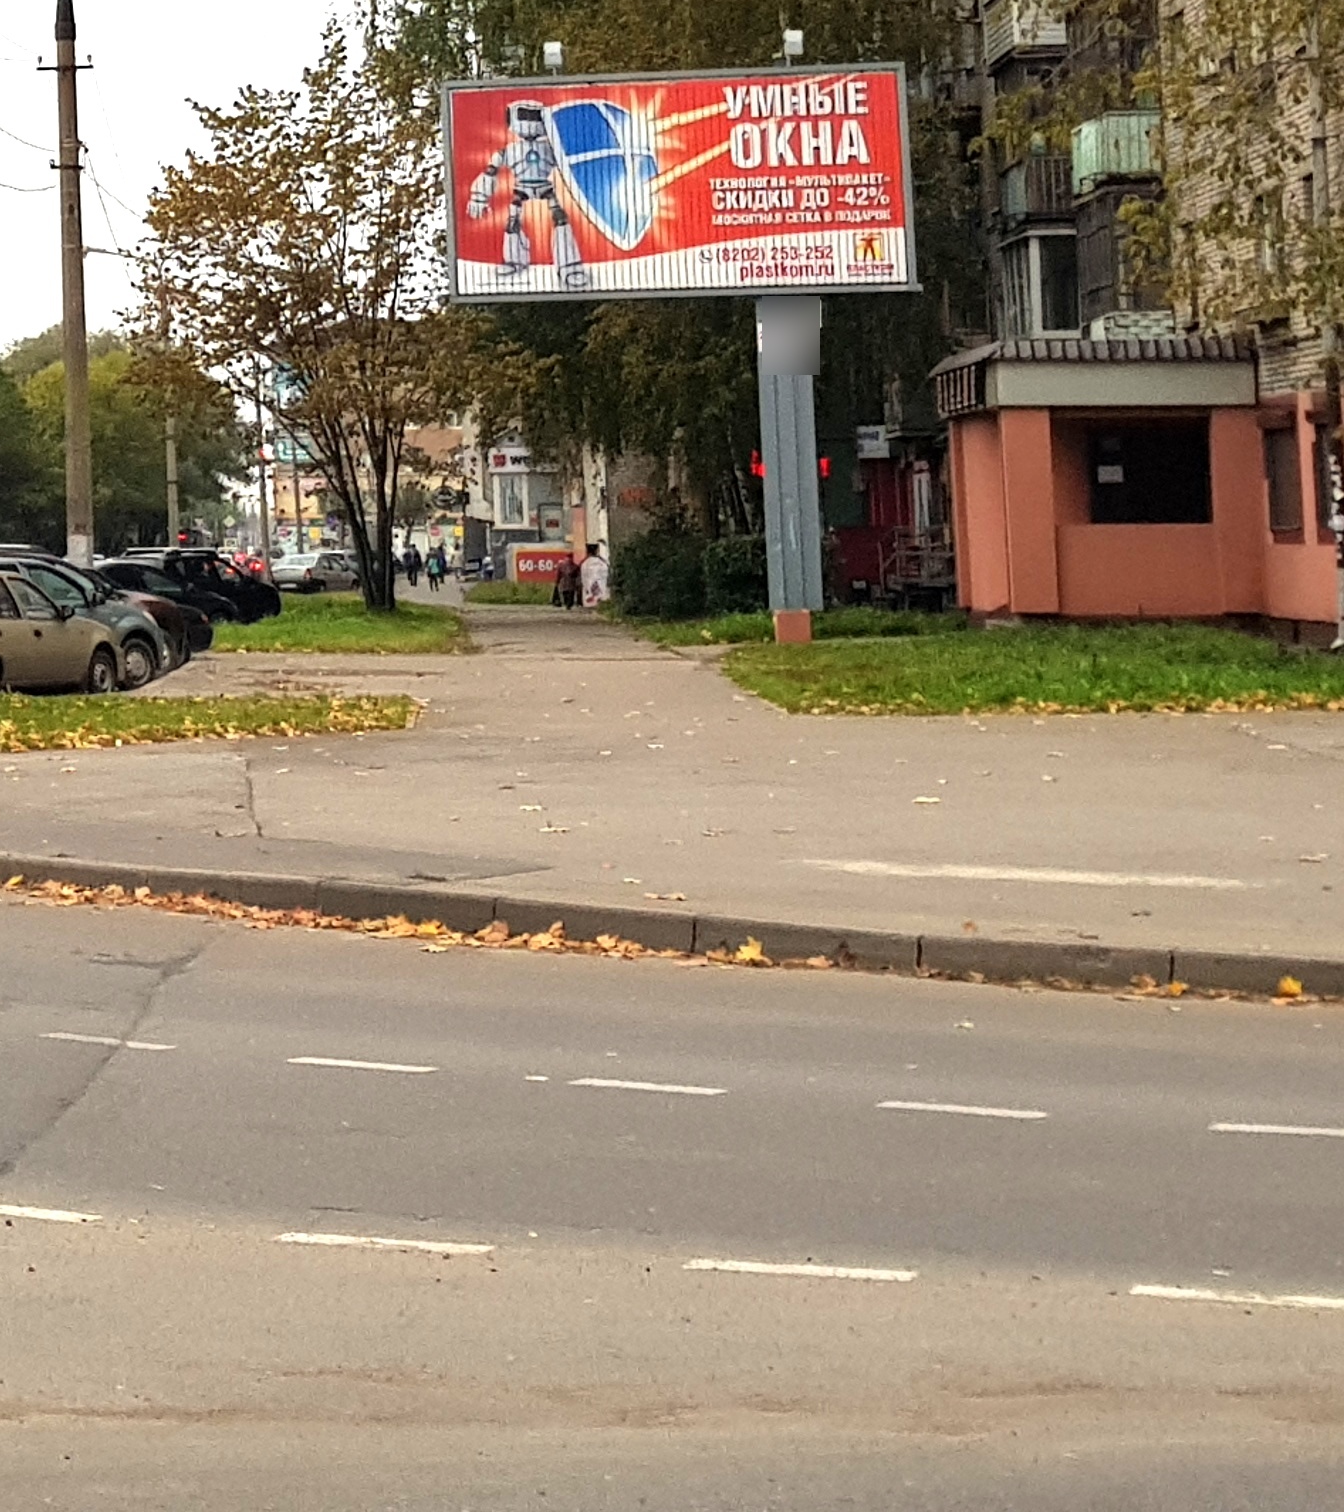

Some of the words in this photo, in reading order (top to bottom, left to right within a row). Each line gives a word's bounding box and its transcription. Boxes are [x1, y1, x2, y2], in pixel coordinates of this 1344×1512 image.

[722, 81, 869, 119] УМНЫЕ
[730, 119, 871, 169] ОКНА
[709, 175, 787, 190] ТЕХНОЛОГИЯ
[712, 189, 794, 211] СКИДКИ
[800, 188, 830, 210] ДО
[836, 186, 890, 206] -42%
[711, 211, 783, 226] МОСКИТНАЯ
[785, 210, 821, 224] СЕТКА
[823, 210, 833, 223] В
[834, 208, 892, 222] ПОДАРОК
[716, 247, 766, 264] (8202)
[739, 261, 835, 281] plastkom.ru
